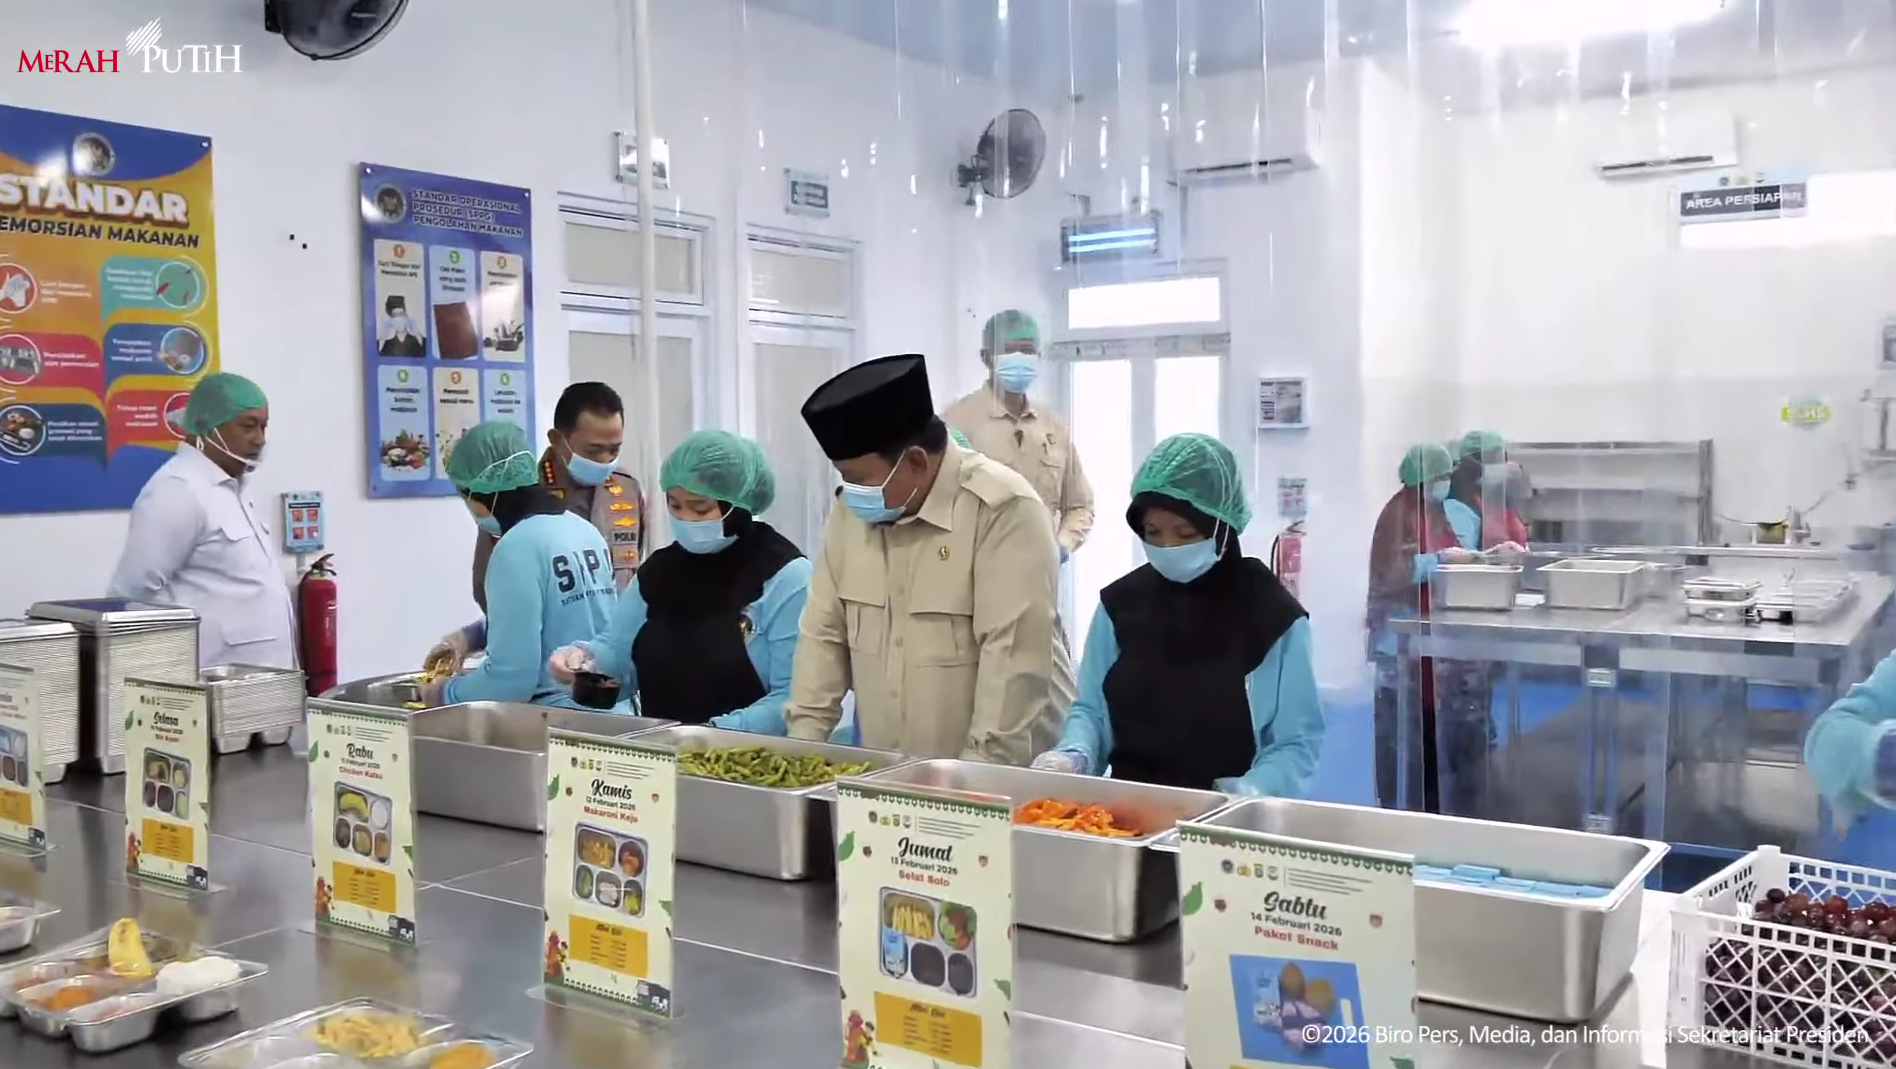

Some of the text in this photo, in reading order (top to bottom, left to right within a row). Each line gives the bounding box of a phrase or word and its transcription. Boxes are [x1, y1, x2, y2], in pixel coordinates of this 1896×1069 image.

[0, 173, 189, 226] STANDAR
[412, 190, 521, 214] STANDAR OPERASIONAL
[412, 203, 463, 218] PROSEDUR
[1686, 197, 1722, 210] AREA
[107, 225, 200, 248] MAKANAN
[413, 215, 524, 238] PENGOLAHAN MAKANAN
[346, 742, 374, 760] Rabu
[591, 778, 633, 800] Kamis
[584, 805, 618, 819] Makaroni
[898, 836, 953, 863] Jumat
[900, 858, 935, 872] Februari
[936, 865, 958, 876] 2026
[927, 874, 950, 887] Solo
[1263, 890, 1328, 920] Sabtu
[1251, 911, 1343, 937] 14 Februari 2026
[1297, 933, 1339, 951] Snack
